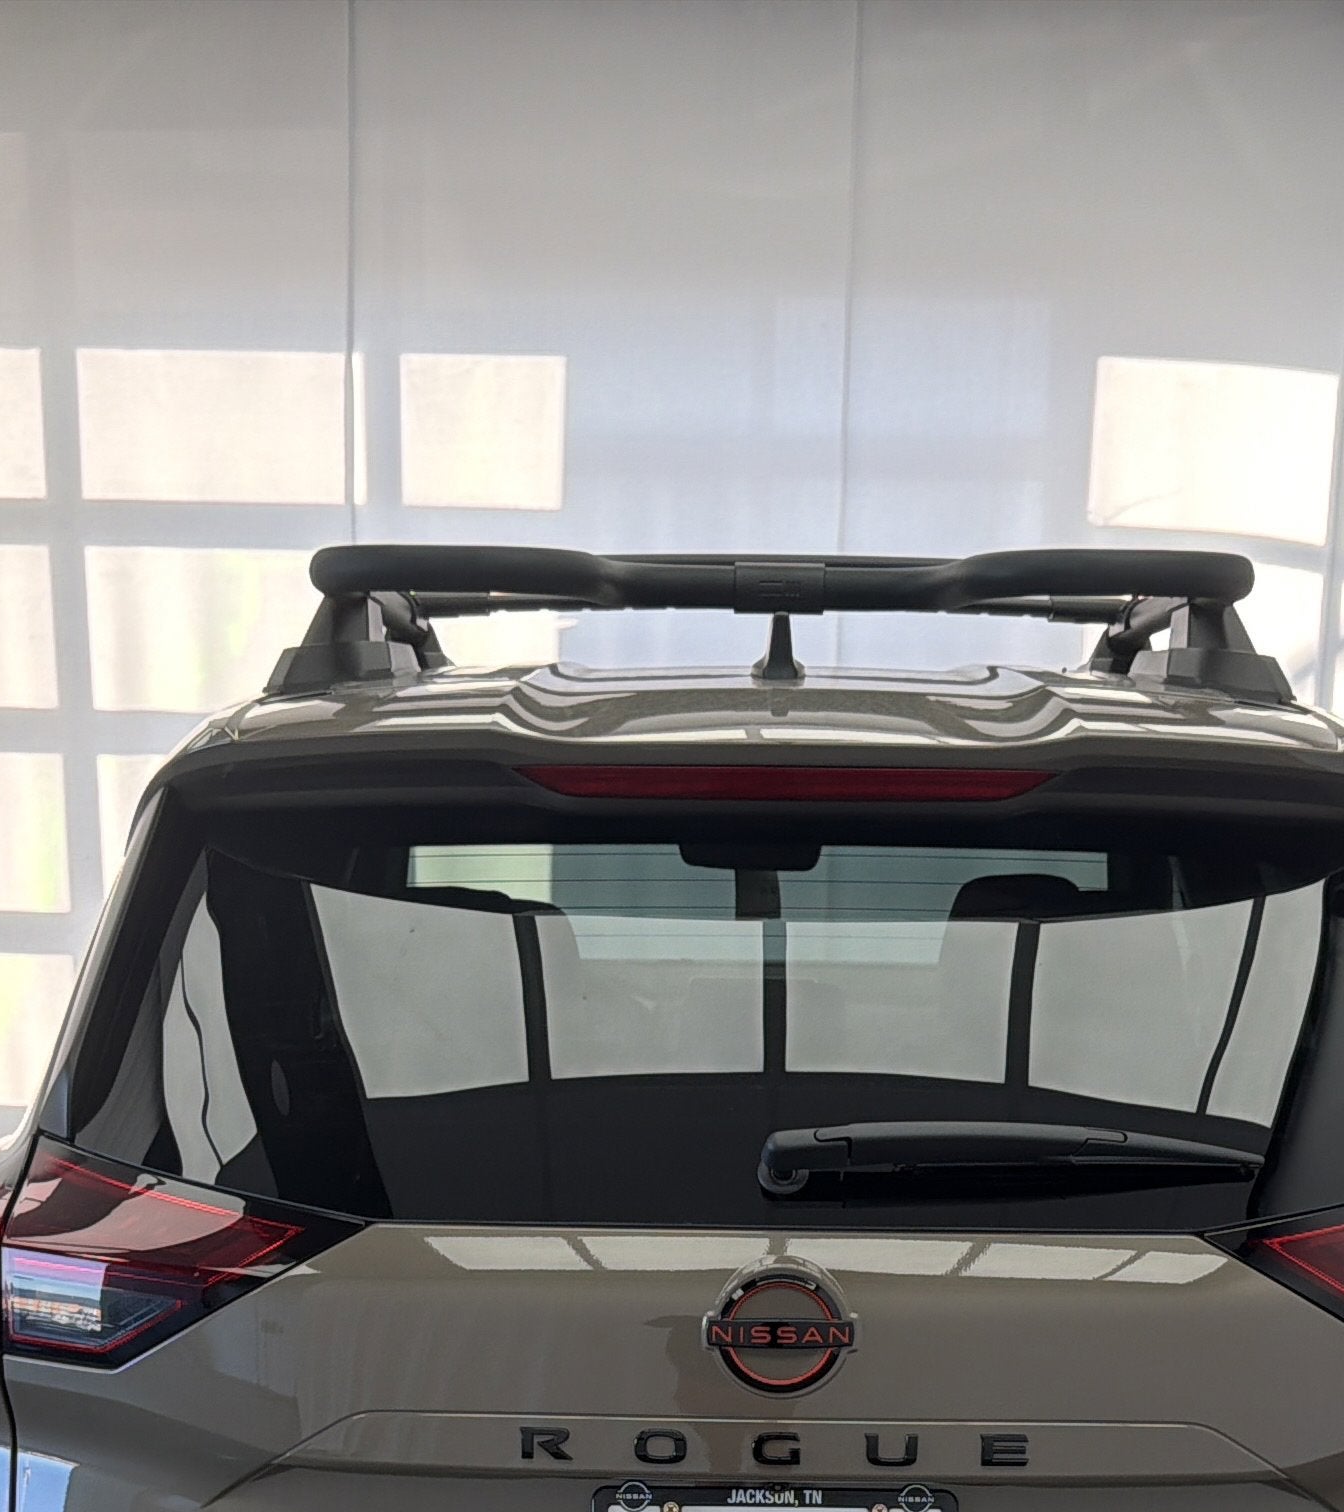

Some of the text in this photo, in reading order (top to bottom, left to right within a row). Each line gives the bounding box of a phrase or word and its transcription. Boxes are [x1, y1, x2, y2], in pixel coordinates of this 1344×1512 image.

[710, 1326, 850, 1345] NISSAN
[519, 1426, 1030, 1468] ROGUE
[727, 1488, 823, 1508] JACKSON, TN
